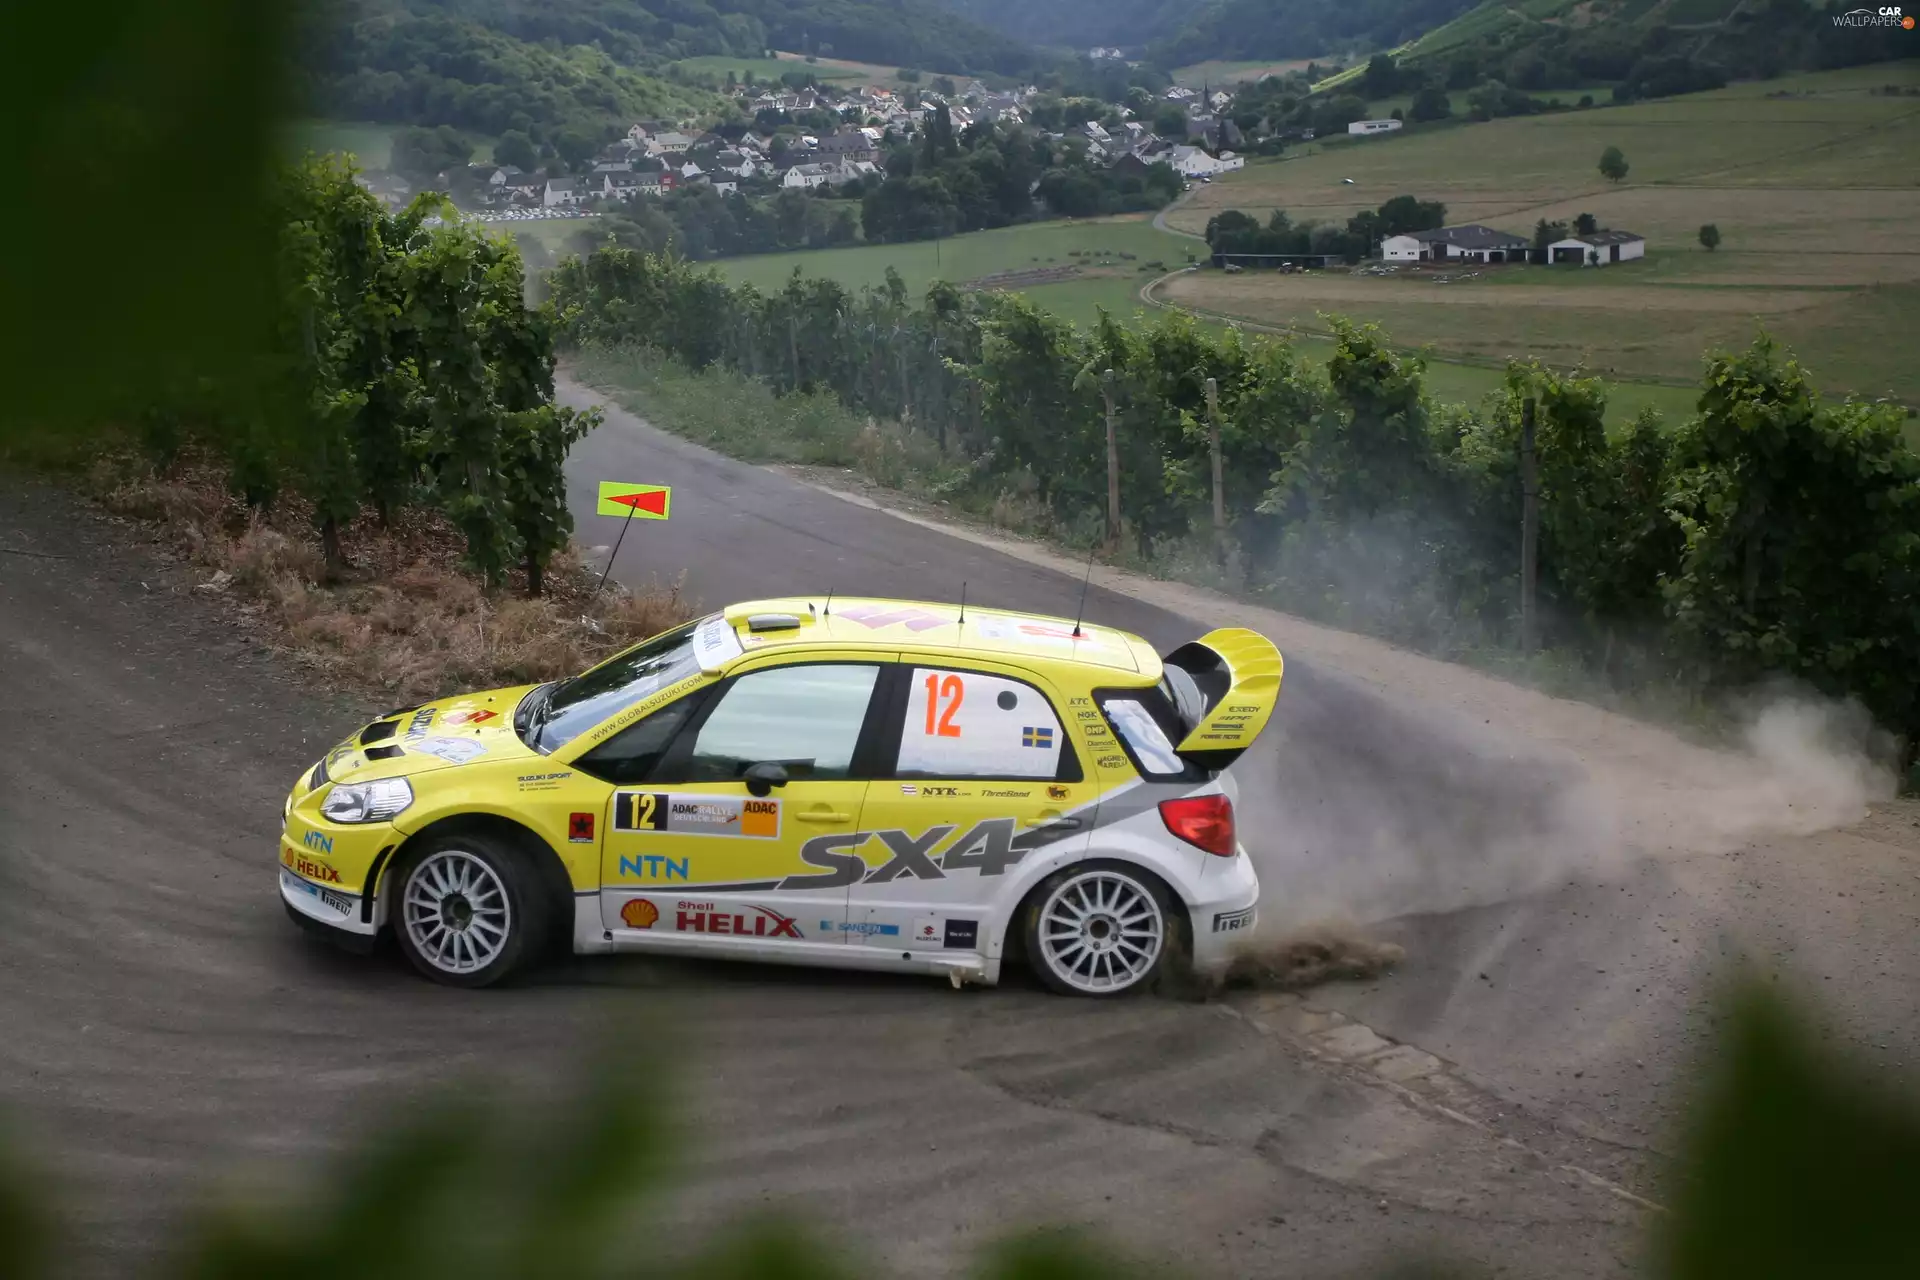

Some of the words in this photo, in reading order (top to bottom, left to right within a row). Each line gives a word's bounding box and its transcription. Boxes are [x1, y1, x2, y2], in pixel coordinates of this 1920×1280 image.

[591, 676, 703, 741] WWW.GLOBALSUZUKI.COM
[925, 674, 964, 737] 12
[922, 787, 958, 796] NYK
[981, 789, 1030, 798] ThreeBond
[630, 794, 656, 829] 12
[672, 804, 698, 814] ADAC
[698, 805, 733, 815] RALLYE
[743, 802, 777, 814] ADAC
[303, 830, 334, 855] NTN
[777, 817, 1033, 890] SX4
[296, 859, 343, 883] HELIX
[619, 854, 689, 880] NTN
[321, 890, 352, 917] PIRELLI
[678, 901, 713, 910] Shell
[676, 910, 803, 939] HELIX
